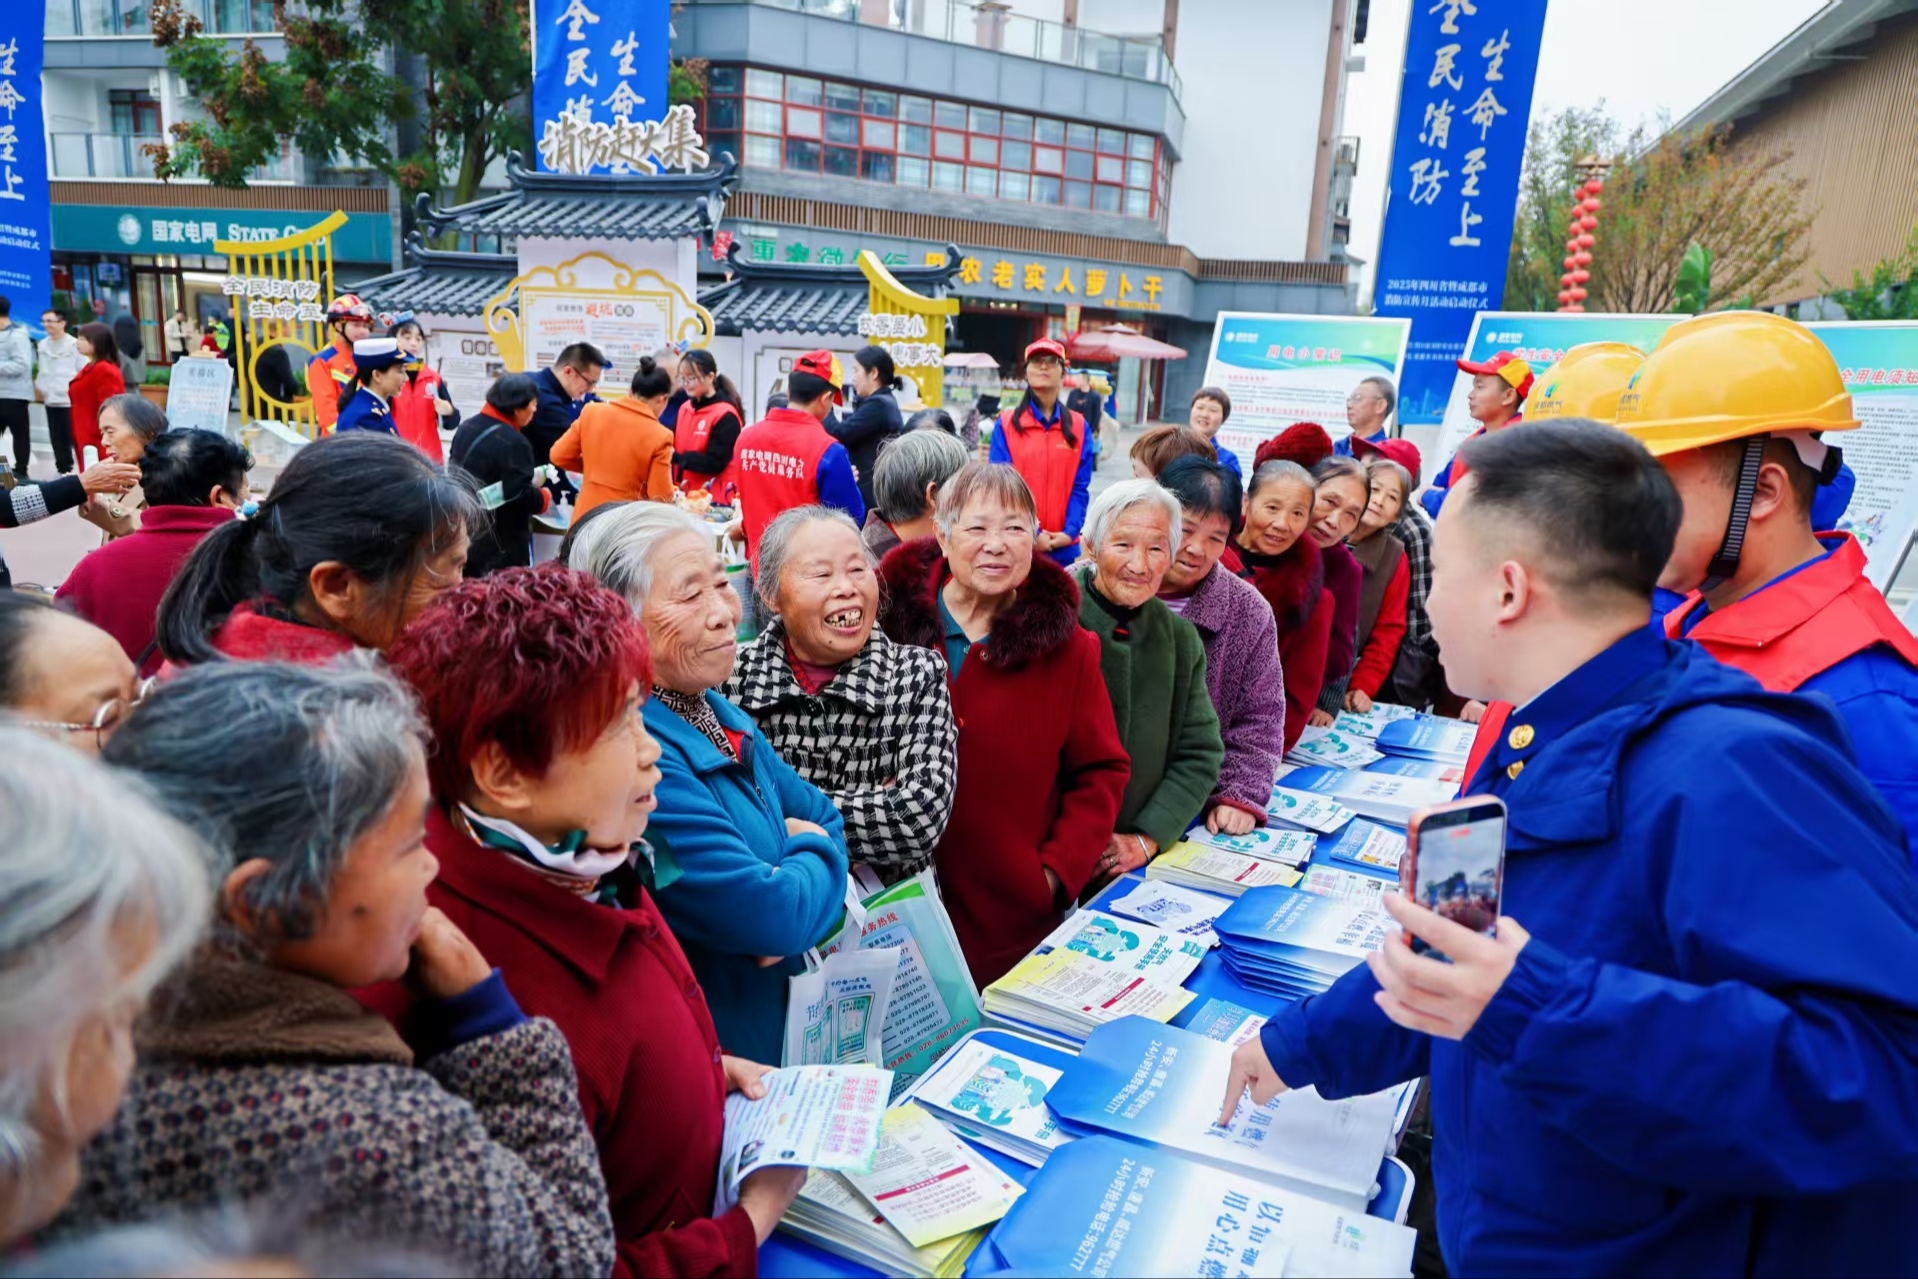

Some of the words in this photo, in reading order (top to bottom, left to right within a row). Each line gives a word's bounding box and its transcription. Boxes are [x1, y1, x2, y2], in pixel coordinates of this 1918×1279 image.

[538, 105, 709, 175] 消防赶大集
[1449, 28, 1511, 247] 生命至上
[152, 219, 218, 244] 国家电网
[751, 239, 909, 265] 惠农微行
[221, 275, 321, 299] 全民消防
[249, 299, 328, 322] 生命至
